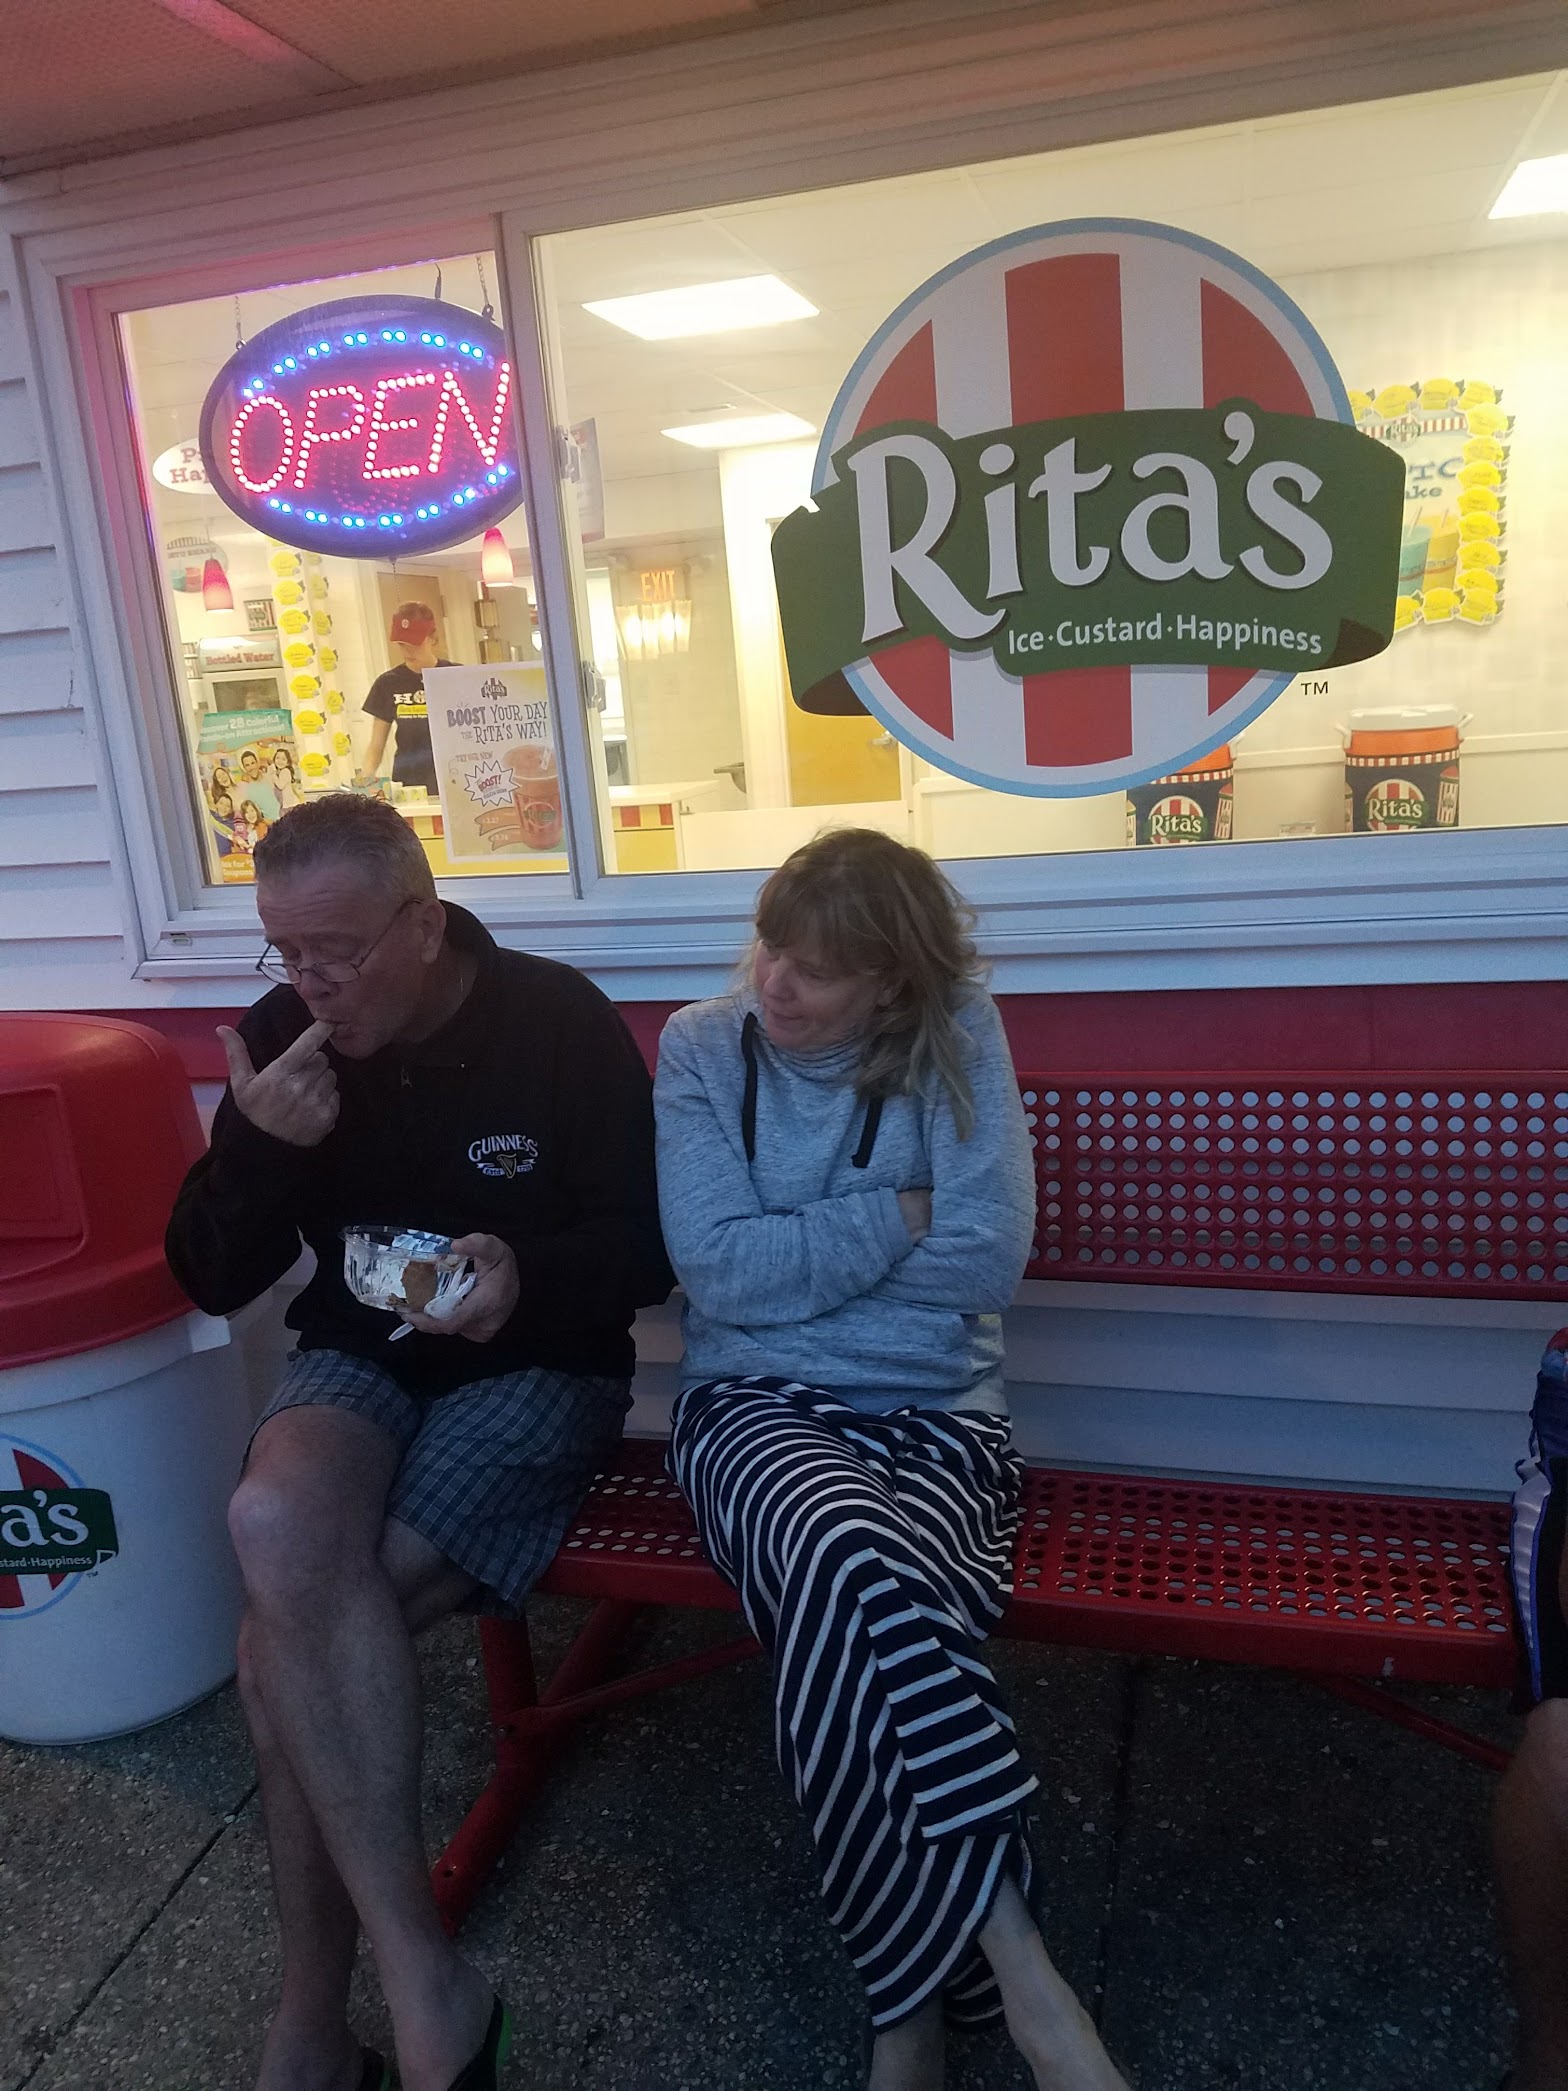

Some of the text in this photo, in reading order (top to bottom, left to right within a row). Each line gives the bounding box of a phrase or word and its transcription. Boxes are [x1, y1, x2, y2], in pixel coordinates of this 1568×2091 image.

[230, 361, 511, 493] OPEN
[847, 411, 1333, 643] Rita's
[640, 570, 675, 602] EXIT
[1008, 612, 1323, 655] Ice Custard Happiness
[206, 652, 275, 665] Bottled Water
[483, 683, 505, 695] Rita's
[1301, 681, 1329, 696] TM
[228, 717, 246, 730] 28
[446, 701, 549, 728] BOOST YOUR DAY
[515, 720, 548, 740] WAY!
[480, 751, 494, 760] NEW
[478, 774, 502, 792] BOOST!
[1369, 798, 1423, 821] Rita's
[1151, 814, 1202, 837] Rita's
[468, 1134, 539, 1162] GUINNESS
[30, 1555, 93, 1569] Happiness
